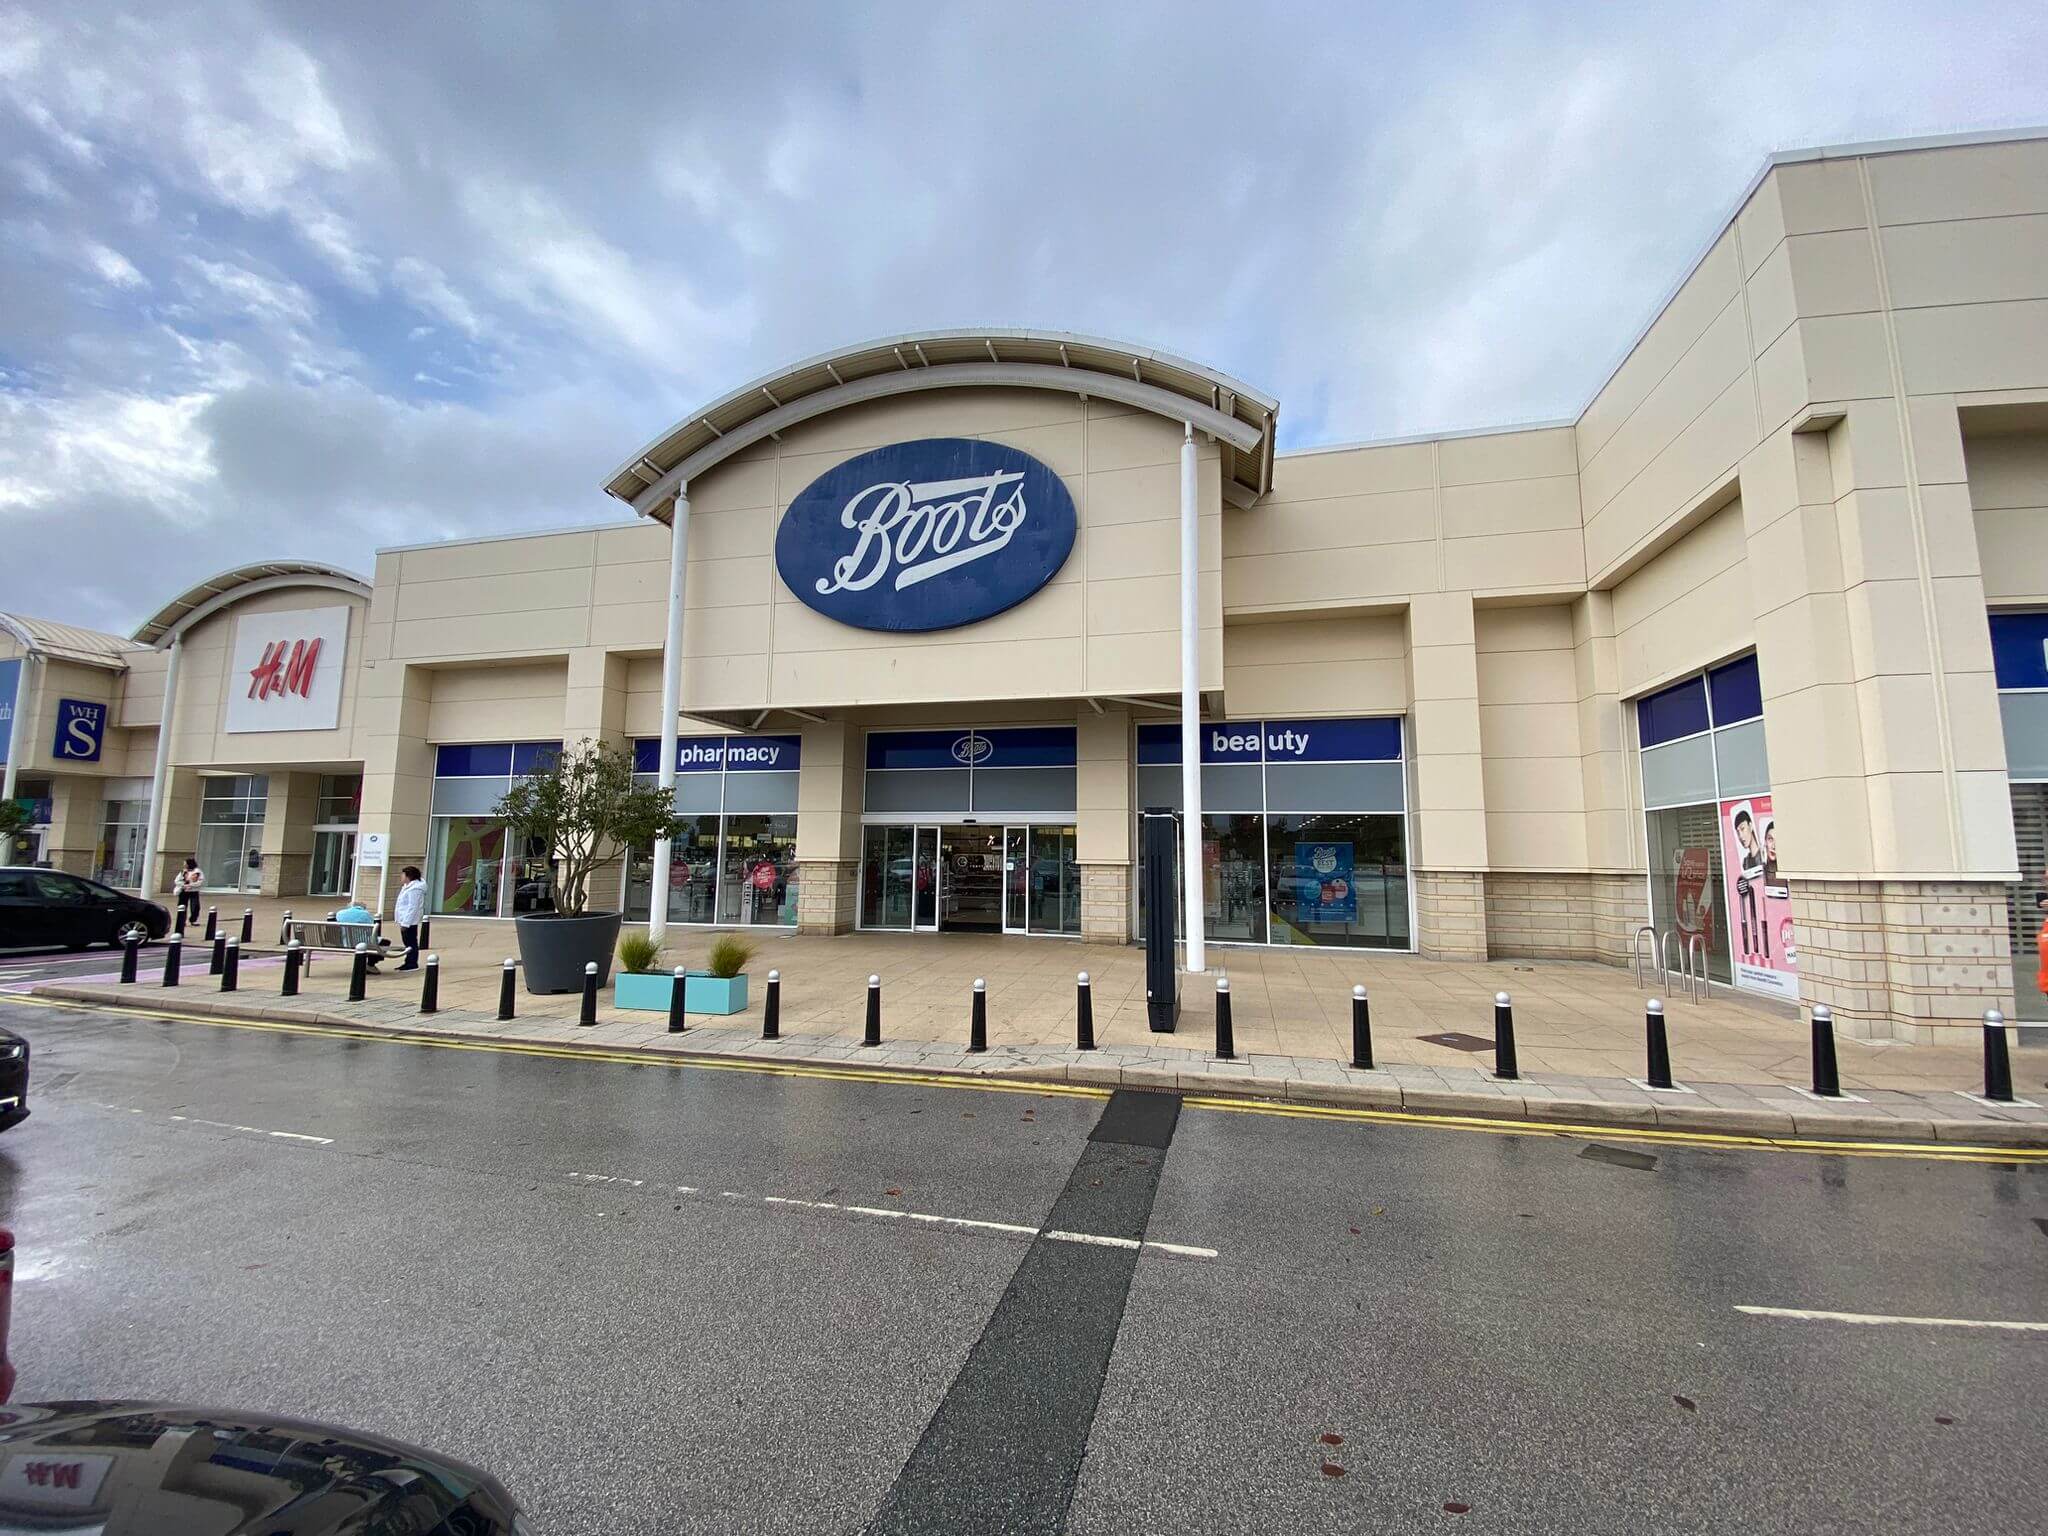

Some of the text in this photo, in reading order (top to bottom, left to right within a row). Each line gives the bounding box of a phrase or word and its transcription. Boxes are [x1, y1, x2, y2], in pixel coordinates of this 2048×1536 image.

[816, 469, 1027, 595] Boots
[248, 638, 322, 700] H&M
[70, 705, 98, 719] WH
[64, 717, 97, 757] S
[1213, 729, 1309, 755] beauty
[680, 744, 780, 766] pharmacy
